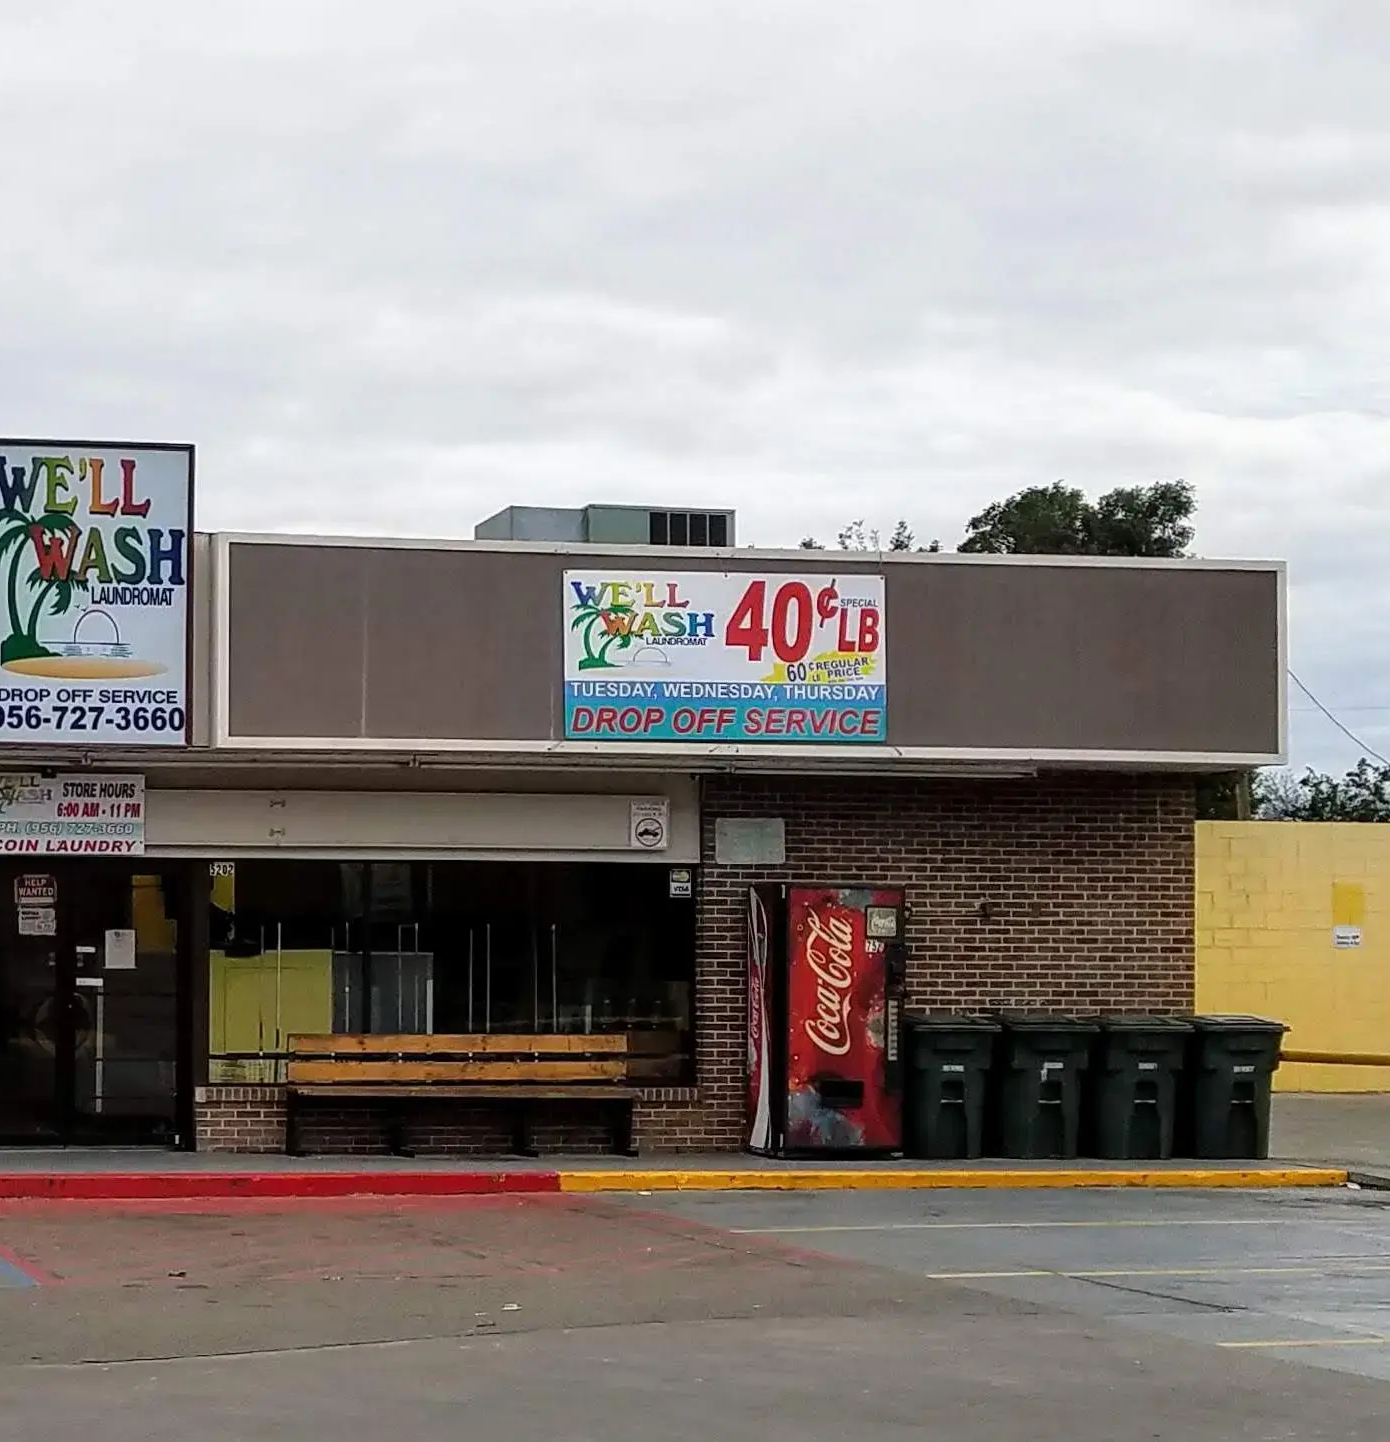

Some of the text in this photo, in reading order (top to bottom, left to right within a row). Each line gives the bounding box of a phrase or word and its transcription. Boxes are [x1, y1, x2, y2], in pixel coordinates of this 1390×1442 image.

[28, 524, 186, 586] WASH
[91, 586, 175, 606] LAUNDROMAT
[570, 581, 690, 608] WE'LL
[840, 597, 879, 608] SPECIAL
[601, 611, 715, 638] WASH
[838, 608, 880, 652] LB
[646, 636, 707, 646] LAUNDROMAT
[816, 657, 869, 671] REGULAR
[827, 666, 860, 679] PRICE
[56, 689, 94, 703] OFF
[98, 690, 178, 704] SERVICE
[570, 682, 880, 701] TUESDAY, WEDNESDAY, THURSDAY
[571, 706, 881, 736] DROP OFF SERVICE
[63, 783, 136, 798] STORE HOURS
[57, 803, 79, 817] 6:00
[82, 803, 99, 817] AM
[110, 803, 121, 817] 11
[124, 803, 141, 818] PM
[25, 821, 62, 835] (956)
[67, 822, 134, 835] 727-3660
[46, 840, 136, 852] LAUNDRY
[18, 887, 54, 896] WANTED
[805, 907, 853, 1056] Coca-Cola
